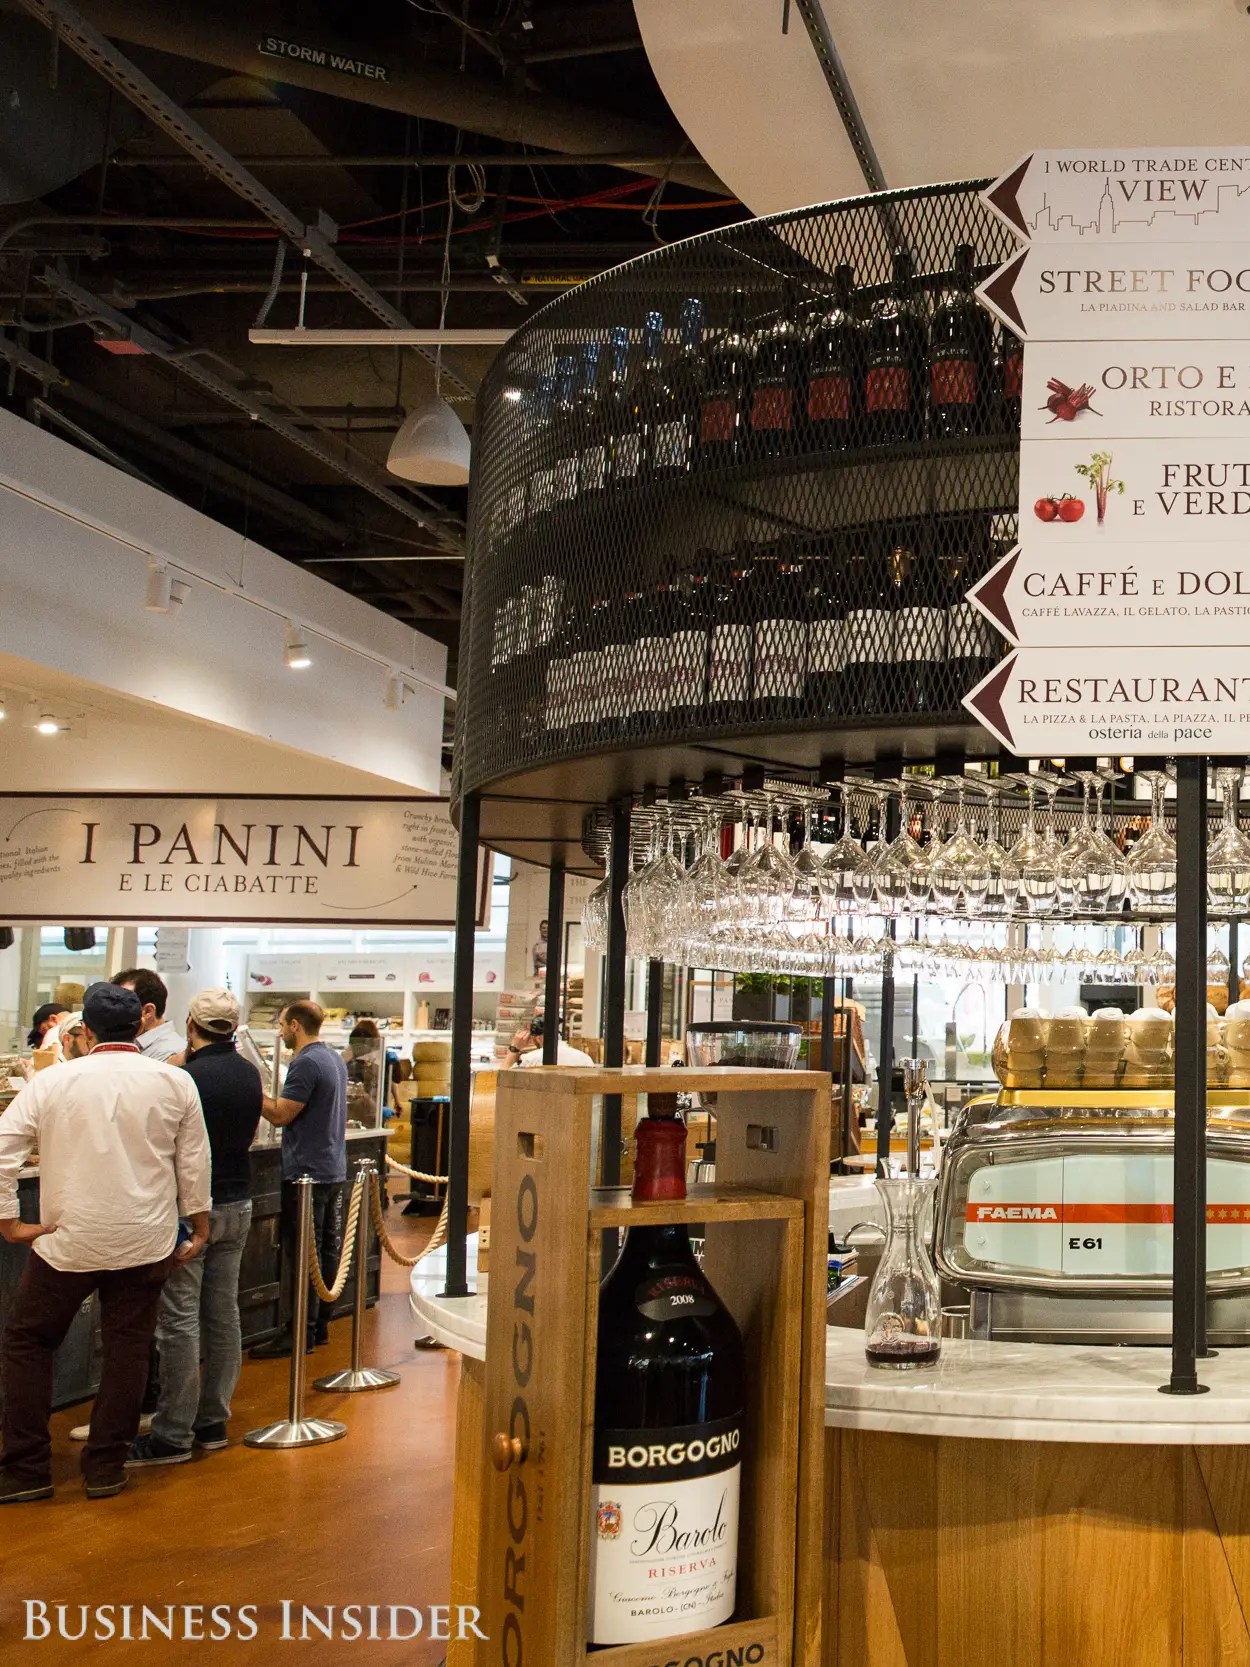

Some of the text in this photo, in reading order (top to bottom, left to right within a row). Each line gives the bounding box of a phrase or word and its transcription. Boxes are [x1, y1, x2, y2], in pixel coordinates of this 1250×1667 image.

[266, 37, 386, 80] STORM WATER
[1044, 161, 1051, 174] 1
[1056, 159, 1126, 174] WORLD
[1131, 158, 1199, 173] TRADE
[1116, 178, 1210, 202] VIEW
[1039, 269, 1175, 295] STREET
[1080, 302, 1246, 312] LA PIADINA AND SALAD BAR
[1101, 365, 1204, 391] ORTO
[1216, 365, 1236, 390] E
[1132, 499, 1146, 516] E
[1023, 566, 1139, 598] CAFFÉ
[1151, 579, 1165, 596] E
[1022, 605, 1060, 617] CAFFÉ
[1062, 607, 1120, 618] LAVAZZA,
[1123, 606, 1136, 617] IL
[1138, 606, 1190, 618] GELATO,
[1194, 606, 1210, 616] LA
[1023, 715, 1039, 724] LA
[1041, 714, 1076, 724] PIZZA
[1078, 714, 1088, 724] &
[1090, 714, 1106, 724] LA
[1153, 714, 1169, 724] LA
[1223, 714, 1236, 724] IL
[1088, 725, 1213, 742] osteria della pace
[79, 822, 364, 868] I PANINI
[118, 873, 320, 895] E LE CIABATTE
[976, 1206, 1058, 1220] FAEMA
[670, 1294, 695, 1306] 2008
[502, 1173, 538, 1667] ORGOGNO
[608, 1428, 740, 1468] BORGOGNO
[630, 1487, 728, 1557] Barolo
[647, 1557, 717, 1579] RISERVA
